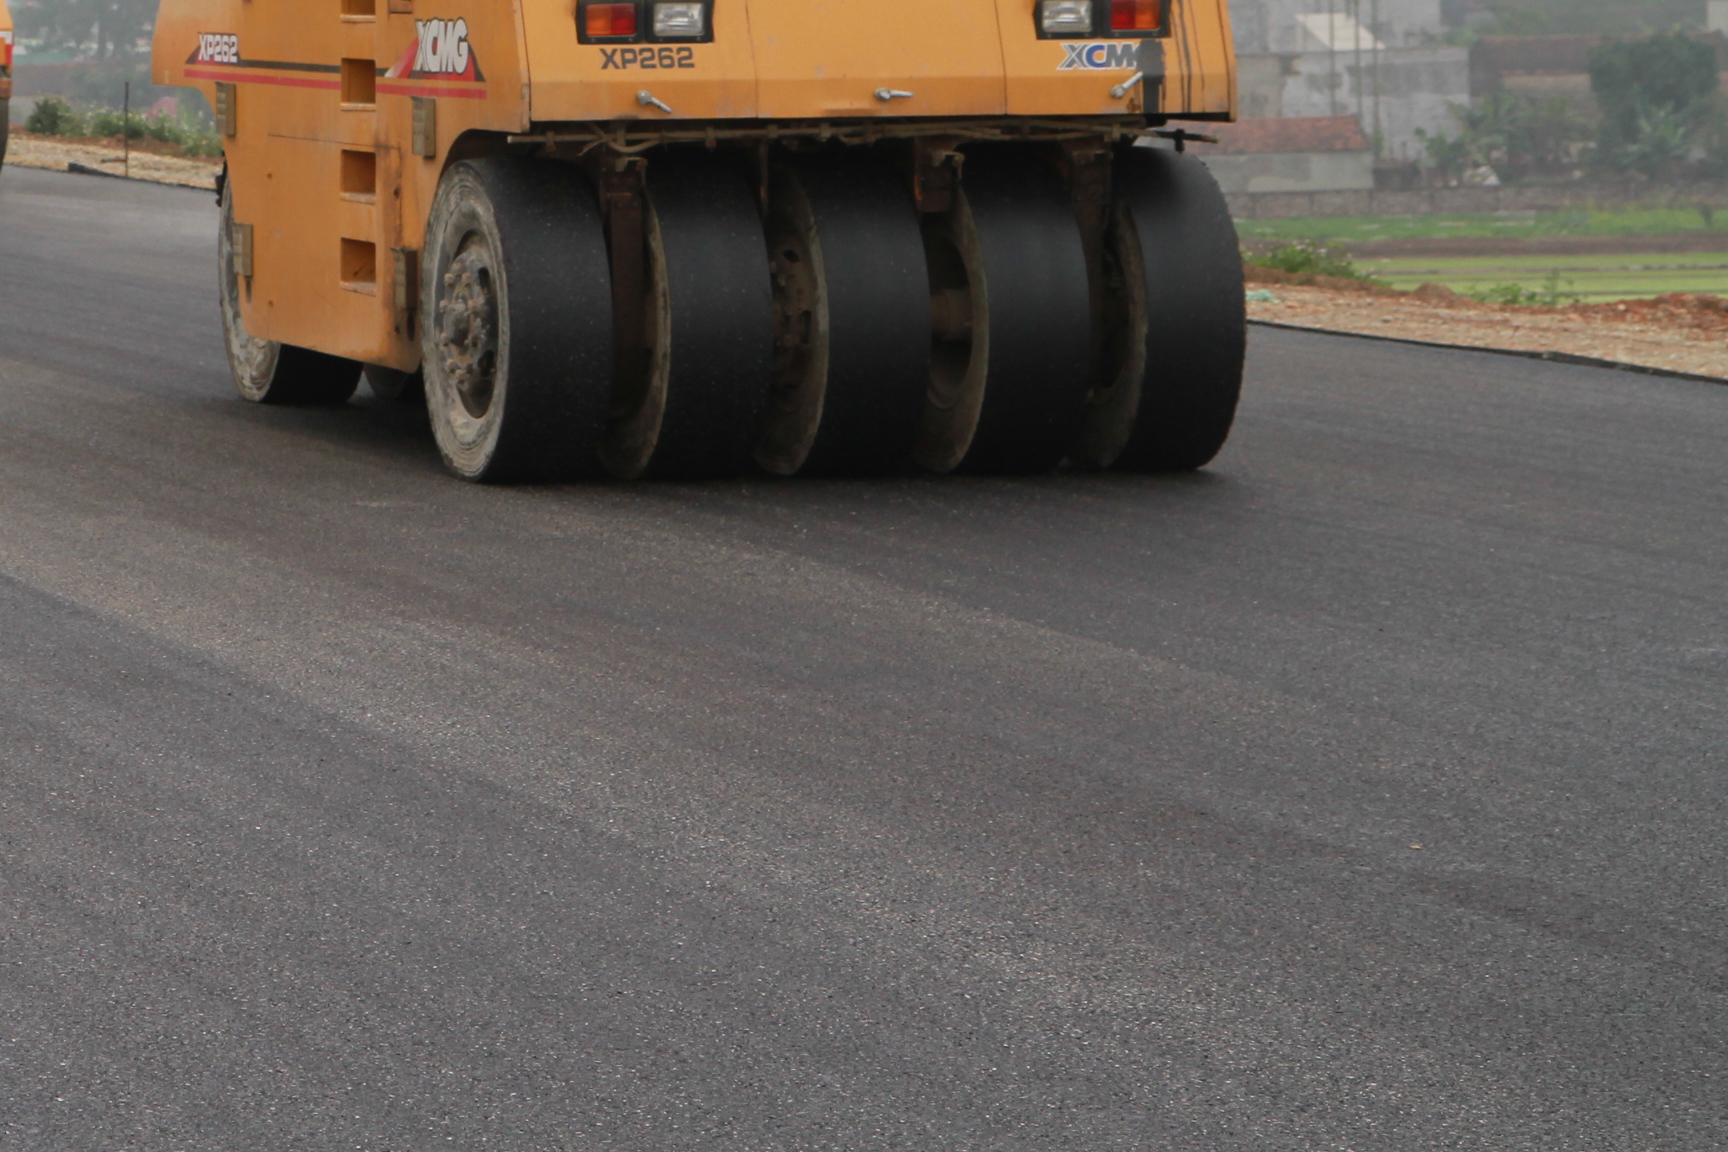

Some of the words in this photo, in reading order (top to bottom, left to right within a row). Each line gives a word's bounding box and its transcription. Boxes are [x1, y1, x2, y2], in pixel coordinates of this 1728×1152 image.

[198, 34, 238, 64] XP262
[413, 18, 469, 75] XCMG
[599, 46, 696, 70] XP262
[1056, 41, 1142, 71] XCM
